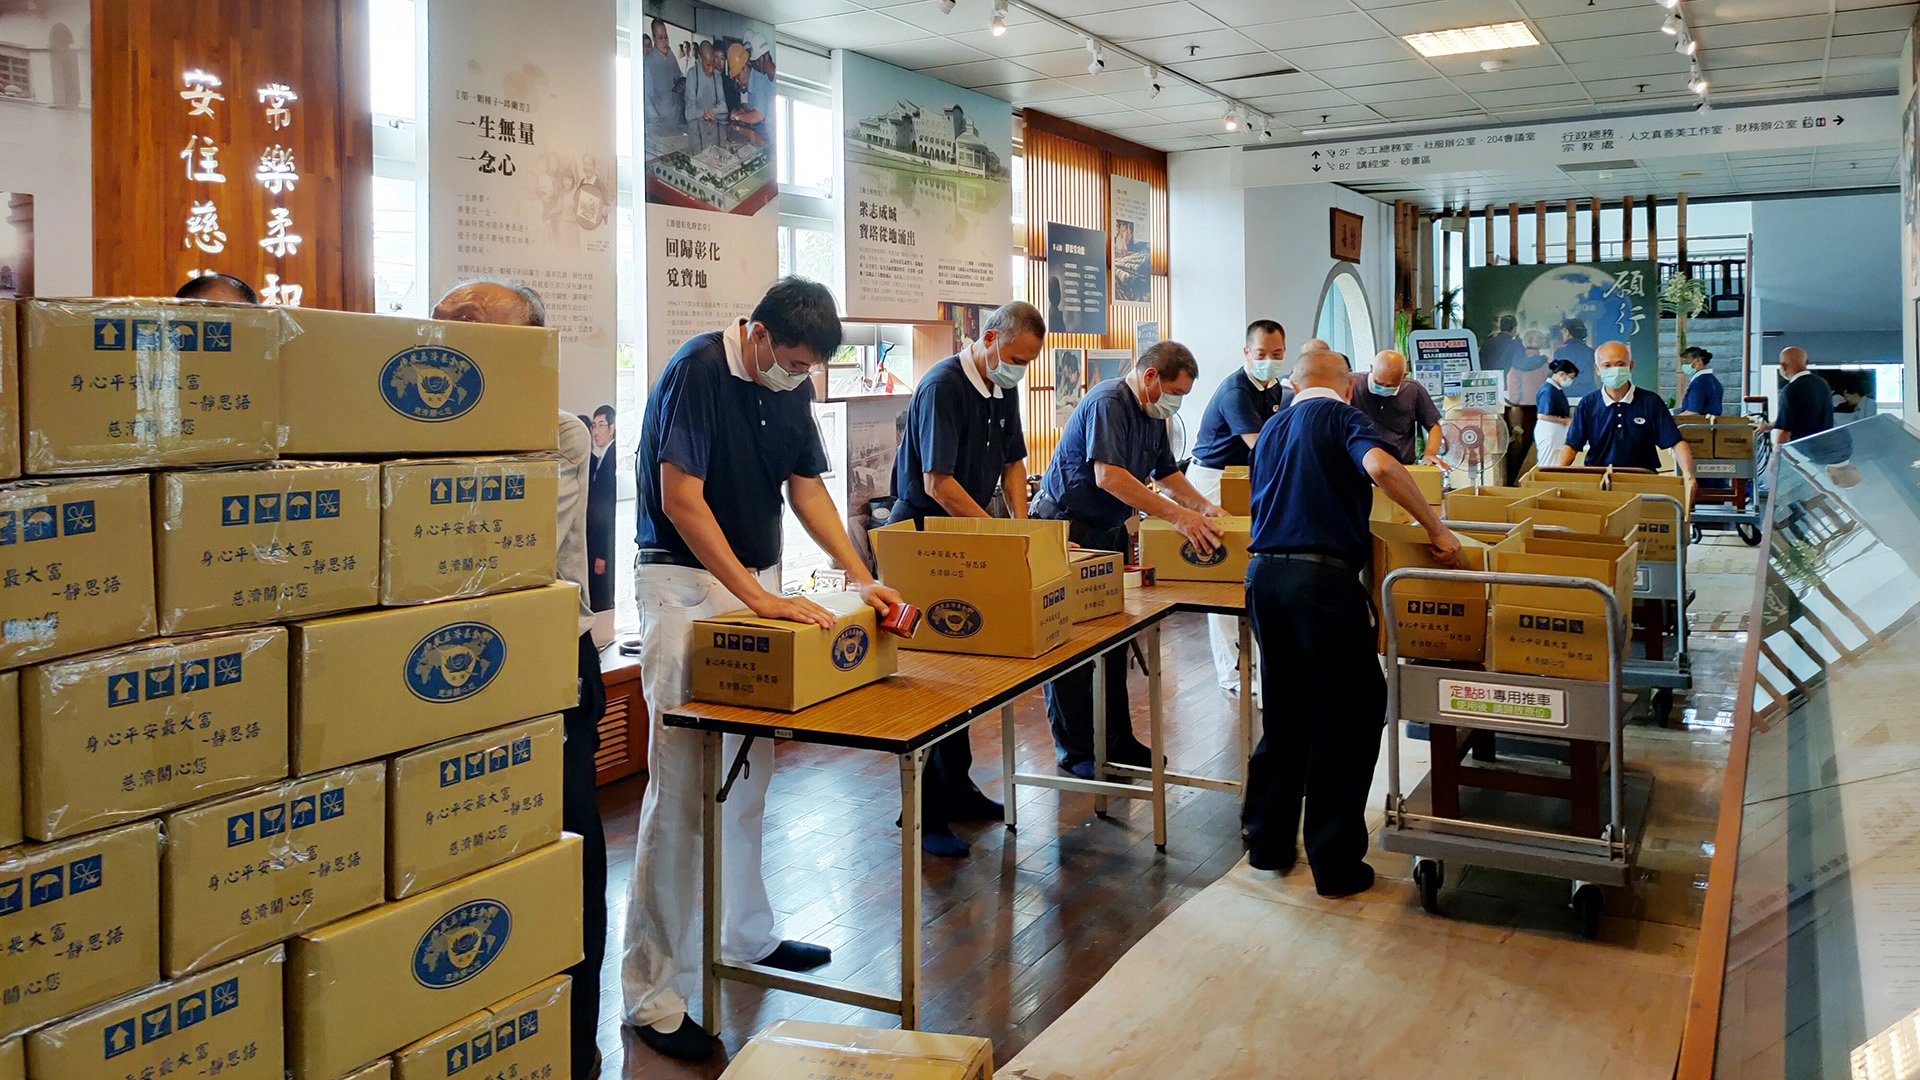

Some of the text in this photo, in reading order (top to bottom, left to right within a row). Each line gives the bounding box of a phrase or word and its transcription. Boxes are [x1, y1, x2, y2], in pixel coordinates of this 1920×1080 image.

[456, 115, 536, 146] 一生無量
[1562, 120, 1798, 141] 行政總務 人文真善美工作室 財務辦公室
[1339, 132, 1536, 156] 2F 志工總務室 社服辦公室 204會議室
[1562, 141, 1614, 152] 宗教處
[180, 69, 227, 277] 安住慈
[457, 150, 516, 176] 一念心
[1339, 155, 1431, 171] B2 講經堂 砂畫區
[256, 83, 302, 306] 常樂柔和
[859, 200, 897, 223] 眾志成城
[666, 237, 721, 262] 回歸彰化
[666, 267, 708, 289] 覓寶地
[1602, 269, 1646, 336] 願行
[70, 373, 200, 392] 身心平安富
[107, 418, 195, 438] 慈濟關您
[413, 519, 503, 539] 身心平安最大富
[3, 562, 62, 589] 最大富
[437, 555, 498, 574] 慈濟關心您
[232, 582, 308, 606] 慈濟關心您
[1450, 685, 1551, 706] 定點B1專用推車
[85, 711, 212, 753] 身心平安最大富
[121, 757, 207, 792] 慈濟關心您
[425, 786, 511, 826] 身心平安最大富
[448, 824, 508, 857] 慈濟關心您
[208, 845, 318, 891] 身心平安富
[240, 888, 314, 926] 慈濟關心您
[0, 922, 67, 957] 最大富
[3, 972, 61, 1005] 關心您
[485, 1062, 518, 1080] 大富
